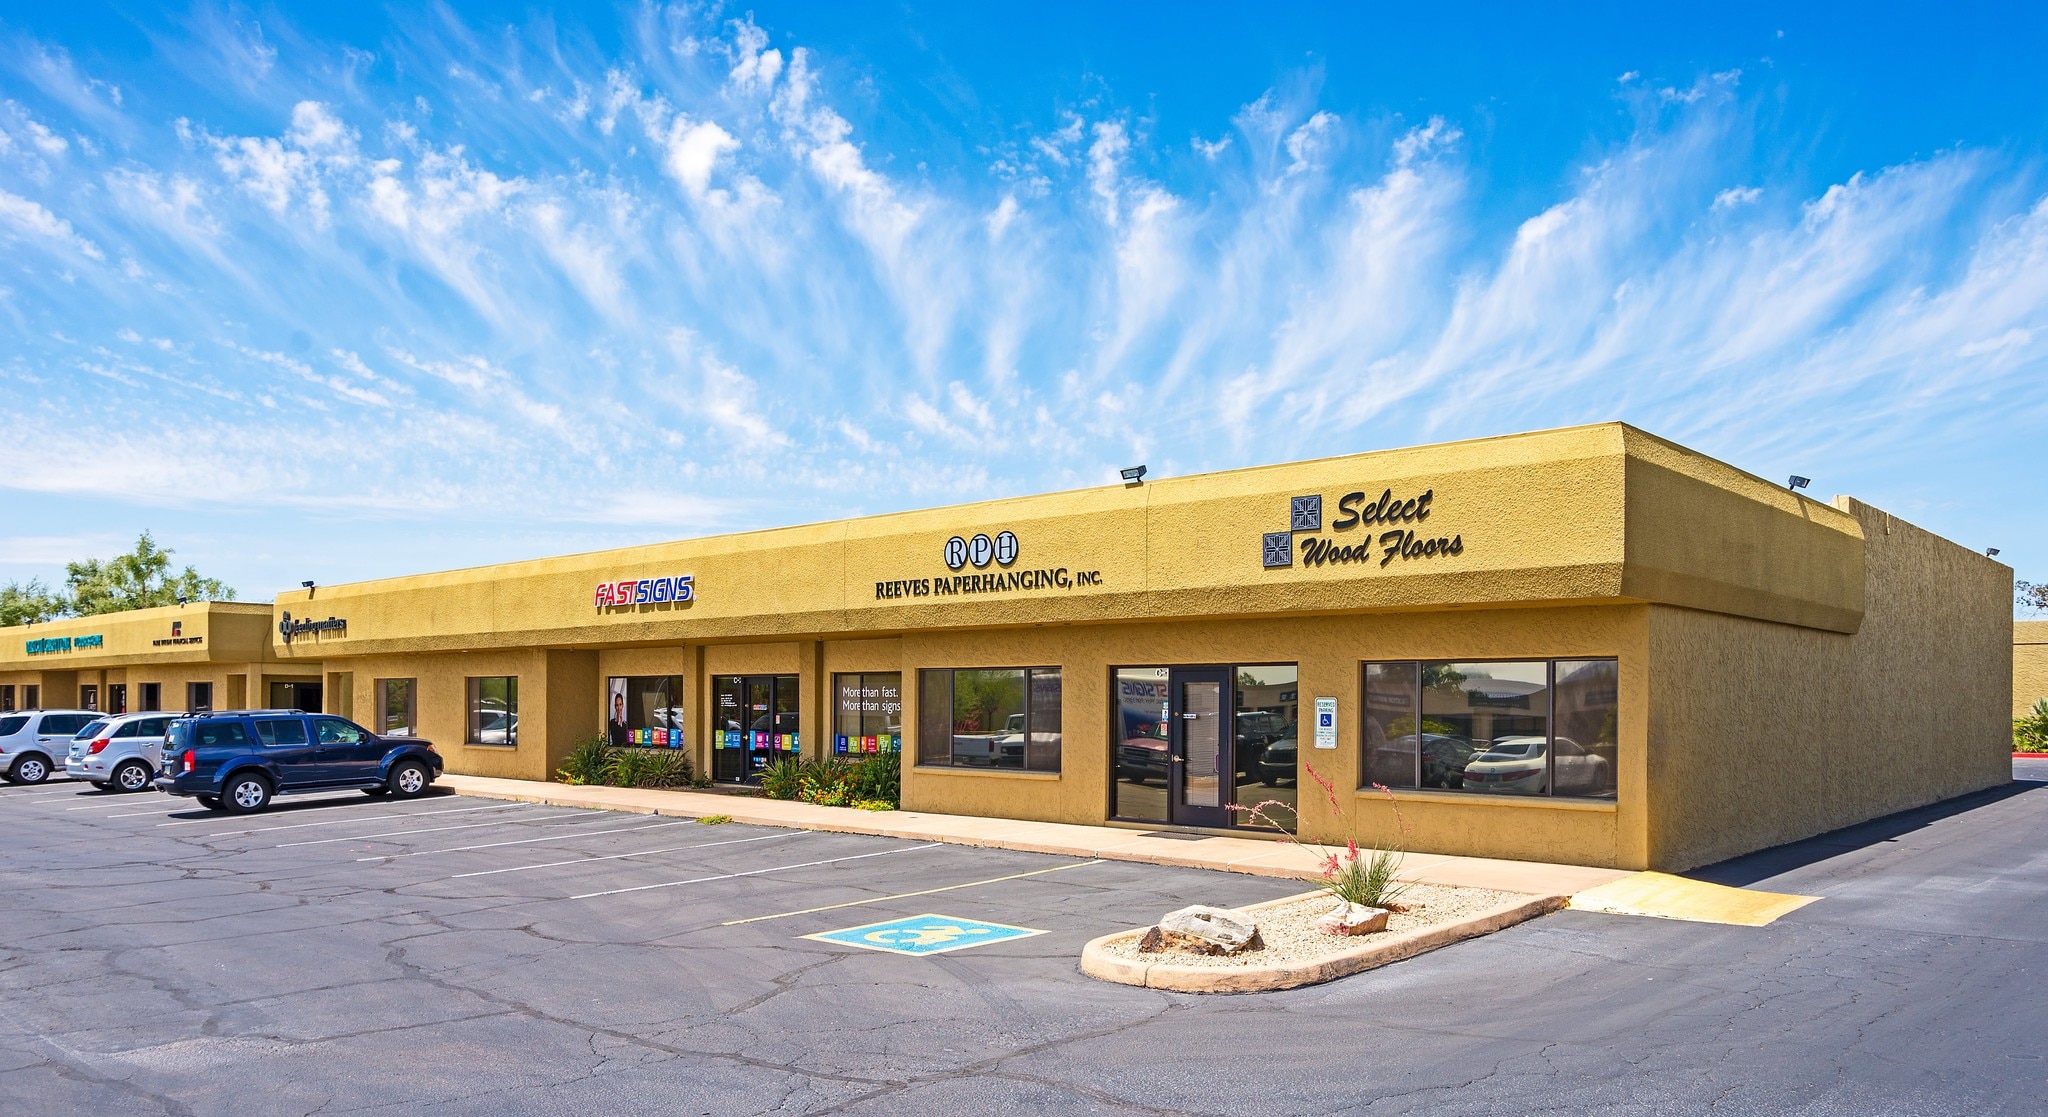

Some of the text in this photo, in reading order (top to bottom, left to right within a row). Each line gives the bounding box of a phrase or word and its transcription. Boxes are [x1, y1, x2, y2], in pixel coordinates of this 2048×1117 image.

[1332, 488, 1433, 530] Select
[1300, 529, 1464, 568] Wood Floors
[593, 574, 693, 608] FASTSIGNS
[875, 567, 1103, 600] REEVES PAPERHANGING, INC.
[842, 686, 899, 698] More than fast.
[842, 700, 861, 711] More
[862, 700, 879, 711] than
